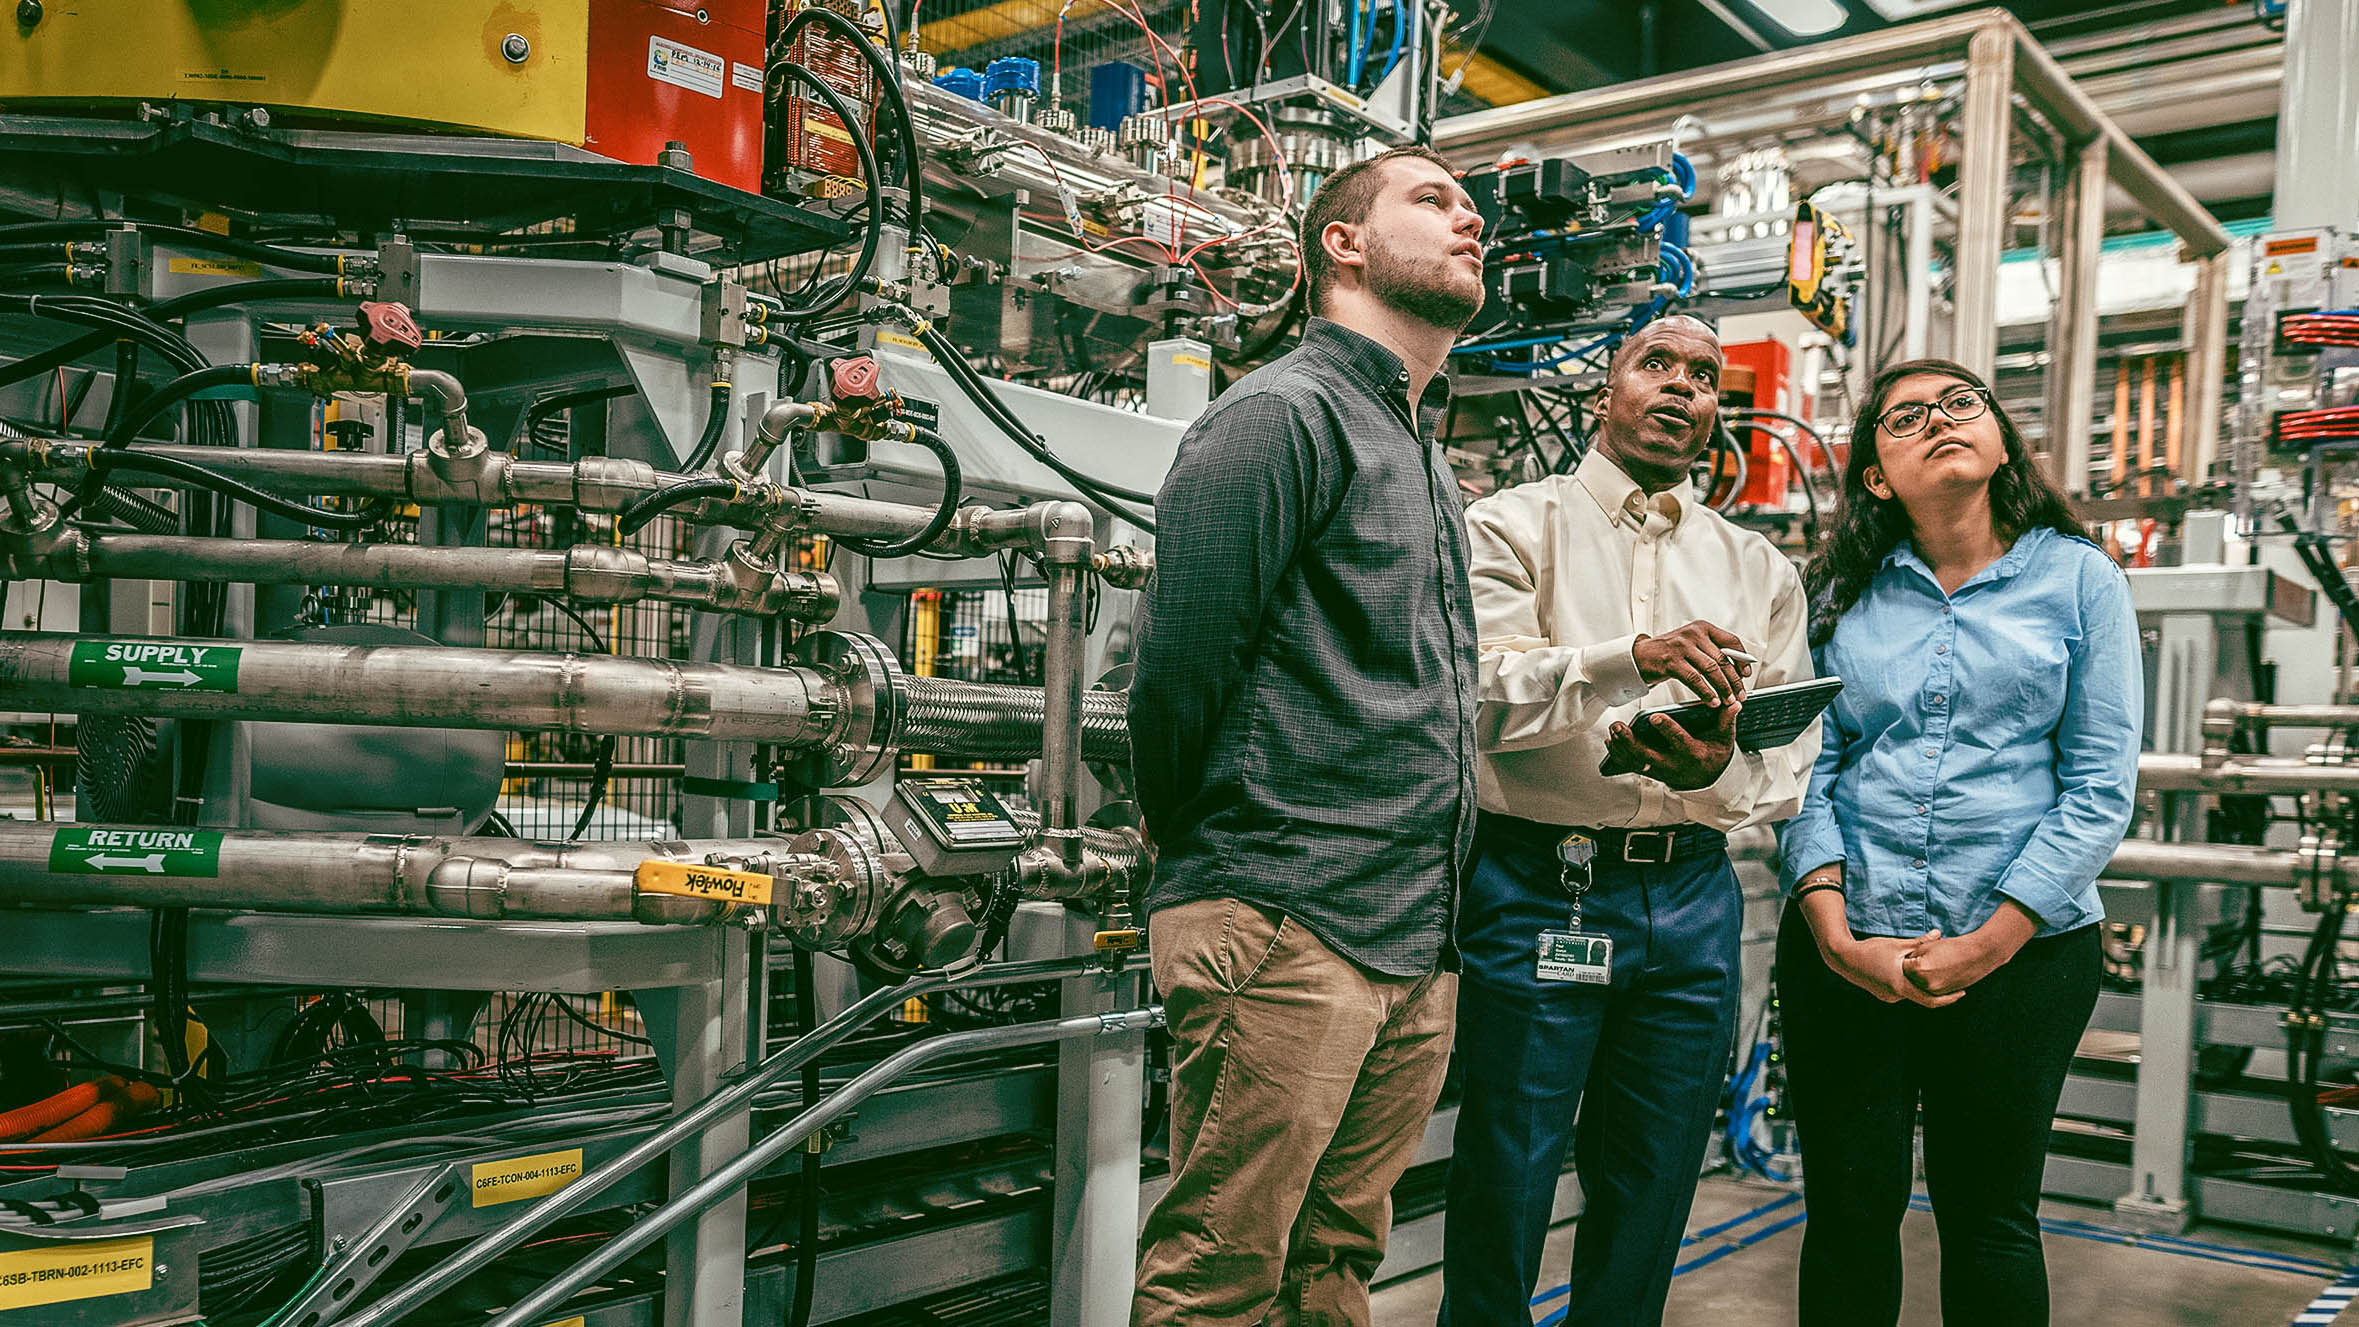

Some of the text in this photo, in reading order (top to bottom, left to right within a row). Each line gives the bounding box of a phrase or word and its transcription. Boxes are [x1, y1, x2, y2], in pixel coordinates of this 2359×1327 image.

[105, 644, 209, 665] SUPPLY
[88, 830, 194, 848] RETURN
[1538, 964, 1575, 973] SPARTAN
[476, 1163, 577, 1189] C6FE-TCON-004-1113-EFC
[0, 1257, 144, 1287] 6SB-TBRN-002-1113-EFC
